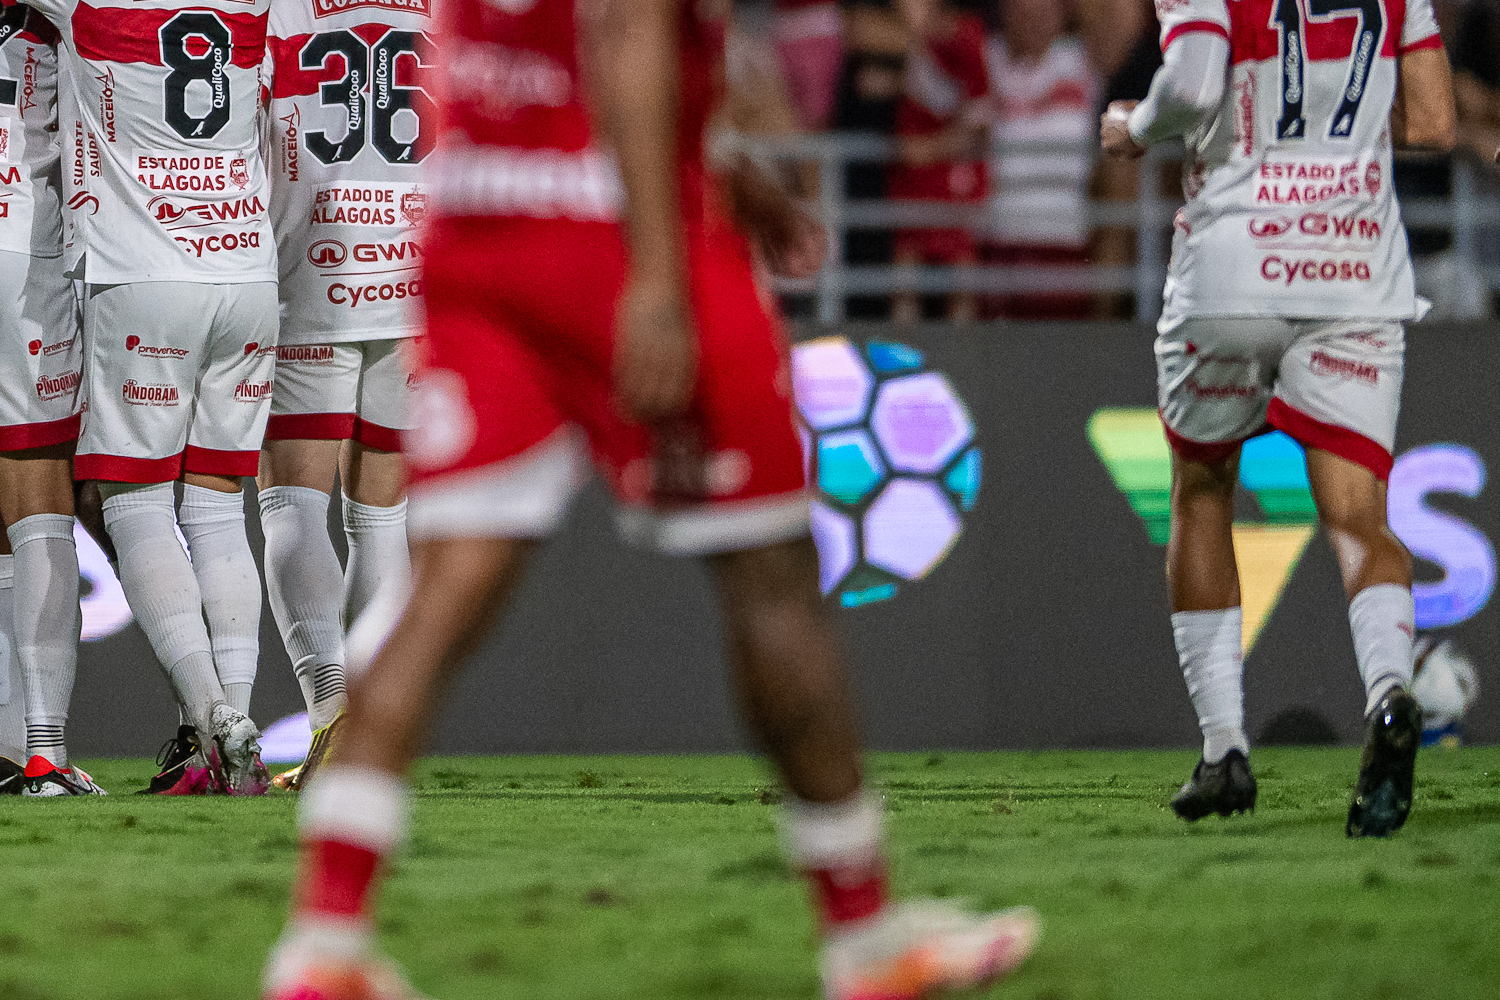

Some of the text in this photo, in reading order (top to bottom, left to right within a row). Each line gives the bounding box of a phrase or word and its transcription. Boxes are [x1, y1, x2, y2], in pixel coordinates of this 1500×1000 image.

[158, 10, 234, 141] 8
[213, 47, 224, 109] QualiCoco
[298, 27, 440, 167] 36
[349, 70, 360, 130] QualiCoco
[377, 48, 388, 110] QualiCoco
[74, 120, 83, 186] SUPORTE
[88, 131, 100, 177] SAÚDE
[138, 156, 224, 171] ESTADO DE
[285, 127, 299, 182] MACEIÓ
[1260, 164, 1336, 180] ESTADO
[310, 207, 396, 226] ALAGOAS
[316, 188, 394, 204] ESTADO DE
[1260, 256, 1371, 285] Cycosa
[276, 345, 334, 361] INDORAMA
